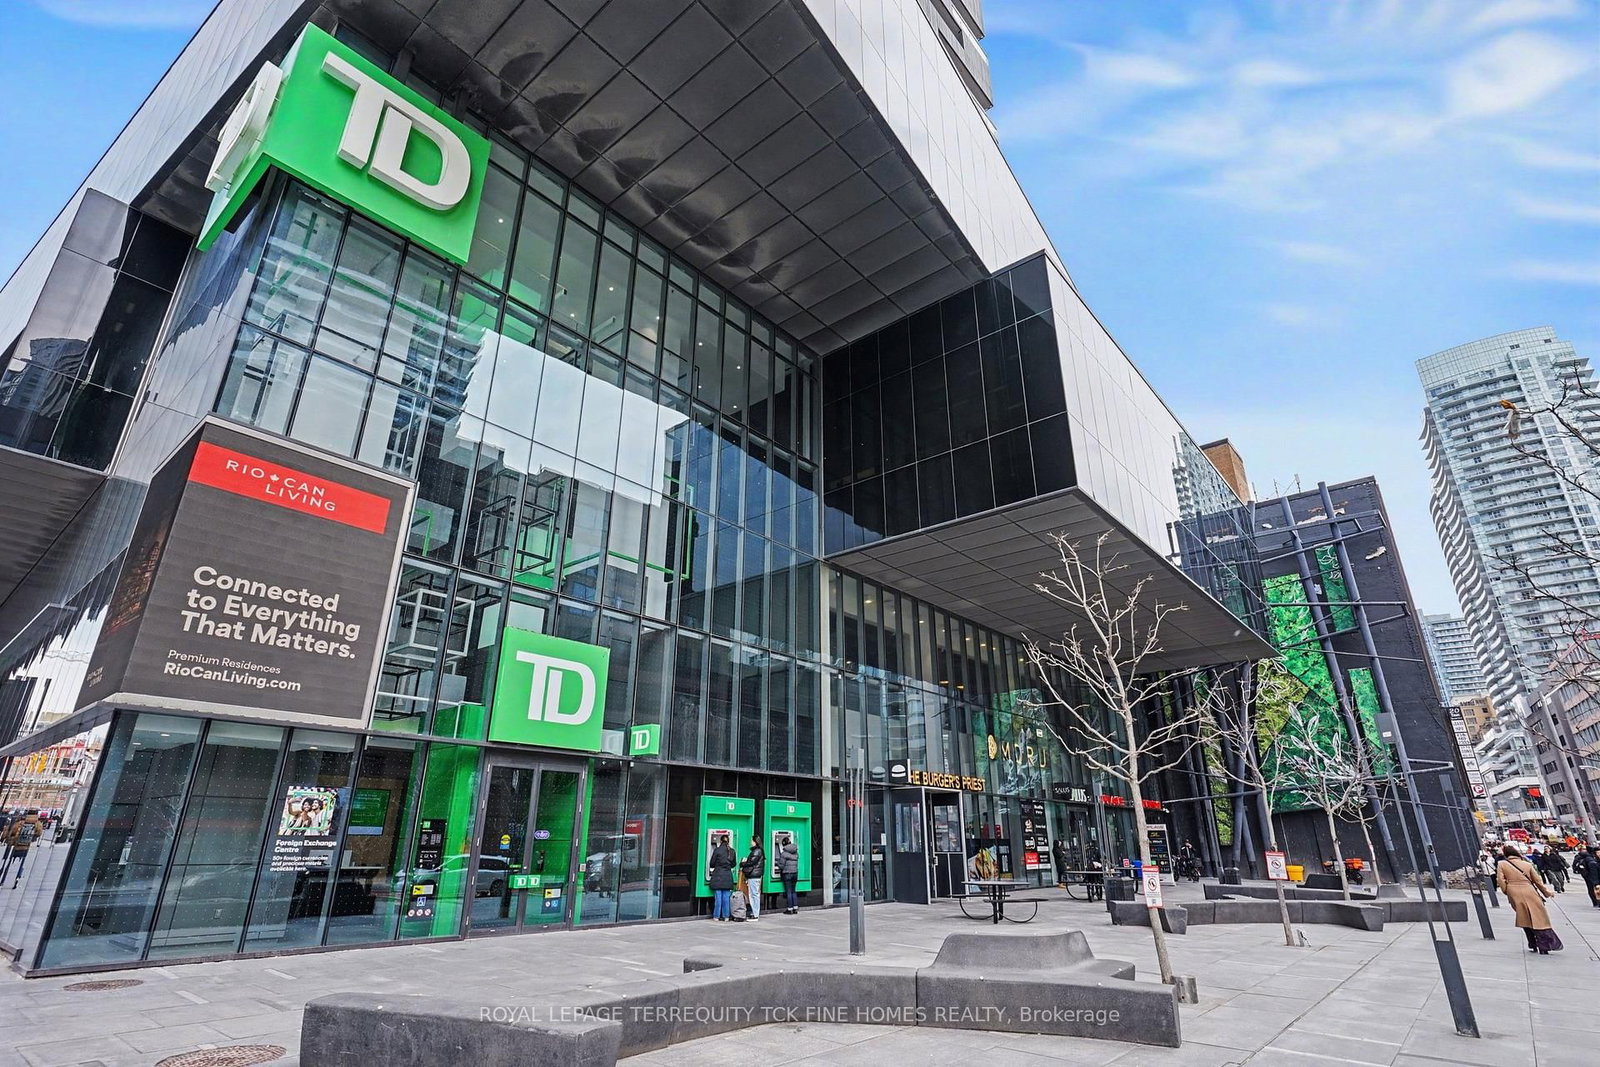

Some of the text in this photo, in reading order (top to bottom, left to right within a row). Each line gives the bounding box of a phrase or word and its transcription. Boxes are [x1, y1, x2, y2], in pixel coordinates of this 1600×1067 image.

[321, 51, 471, 211] TD
[225, 459, 326, 498] RIO CAN
[265, 483, 337, 512] LIVING
[193, 565, 340, 613] Connected
[187, 588, 361, 642] to Everything
[181, 610, 356, 659] That Matters.
[168, 649, 281, 675] Premium Residences
[163, 662, 301, 692] RioCanLiving.com
[516, 650, 596, 726] TD
[632, 729, 650, 750] TD
[909, 770, 986, 793] HE BURGER'S PRIEST
[276, 839, 337, 848] Foreign Exchange
[516, 877, 527, 887] TD
[530, 877, 540, 886] TD
